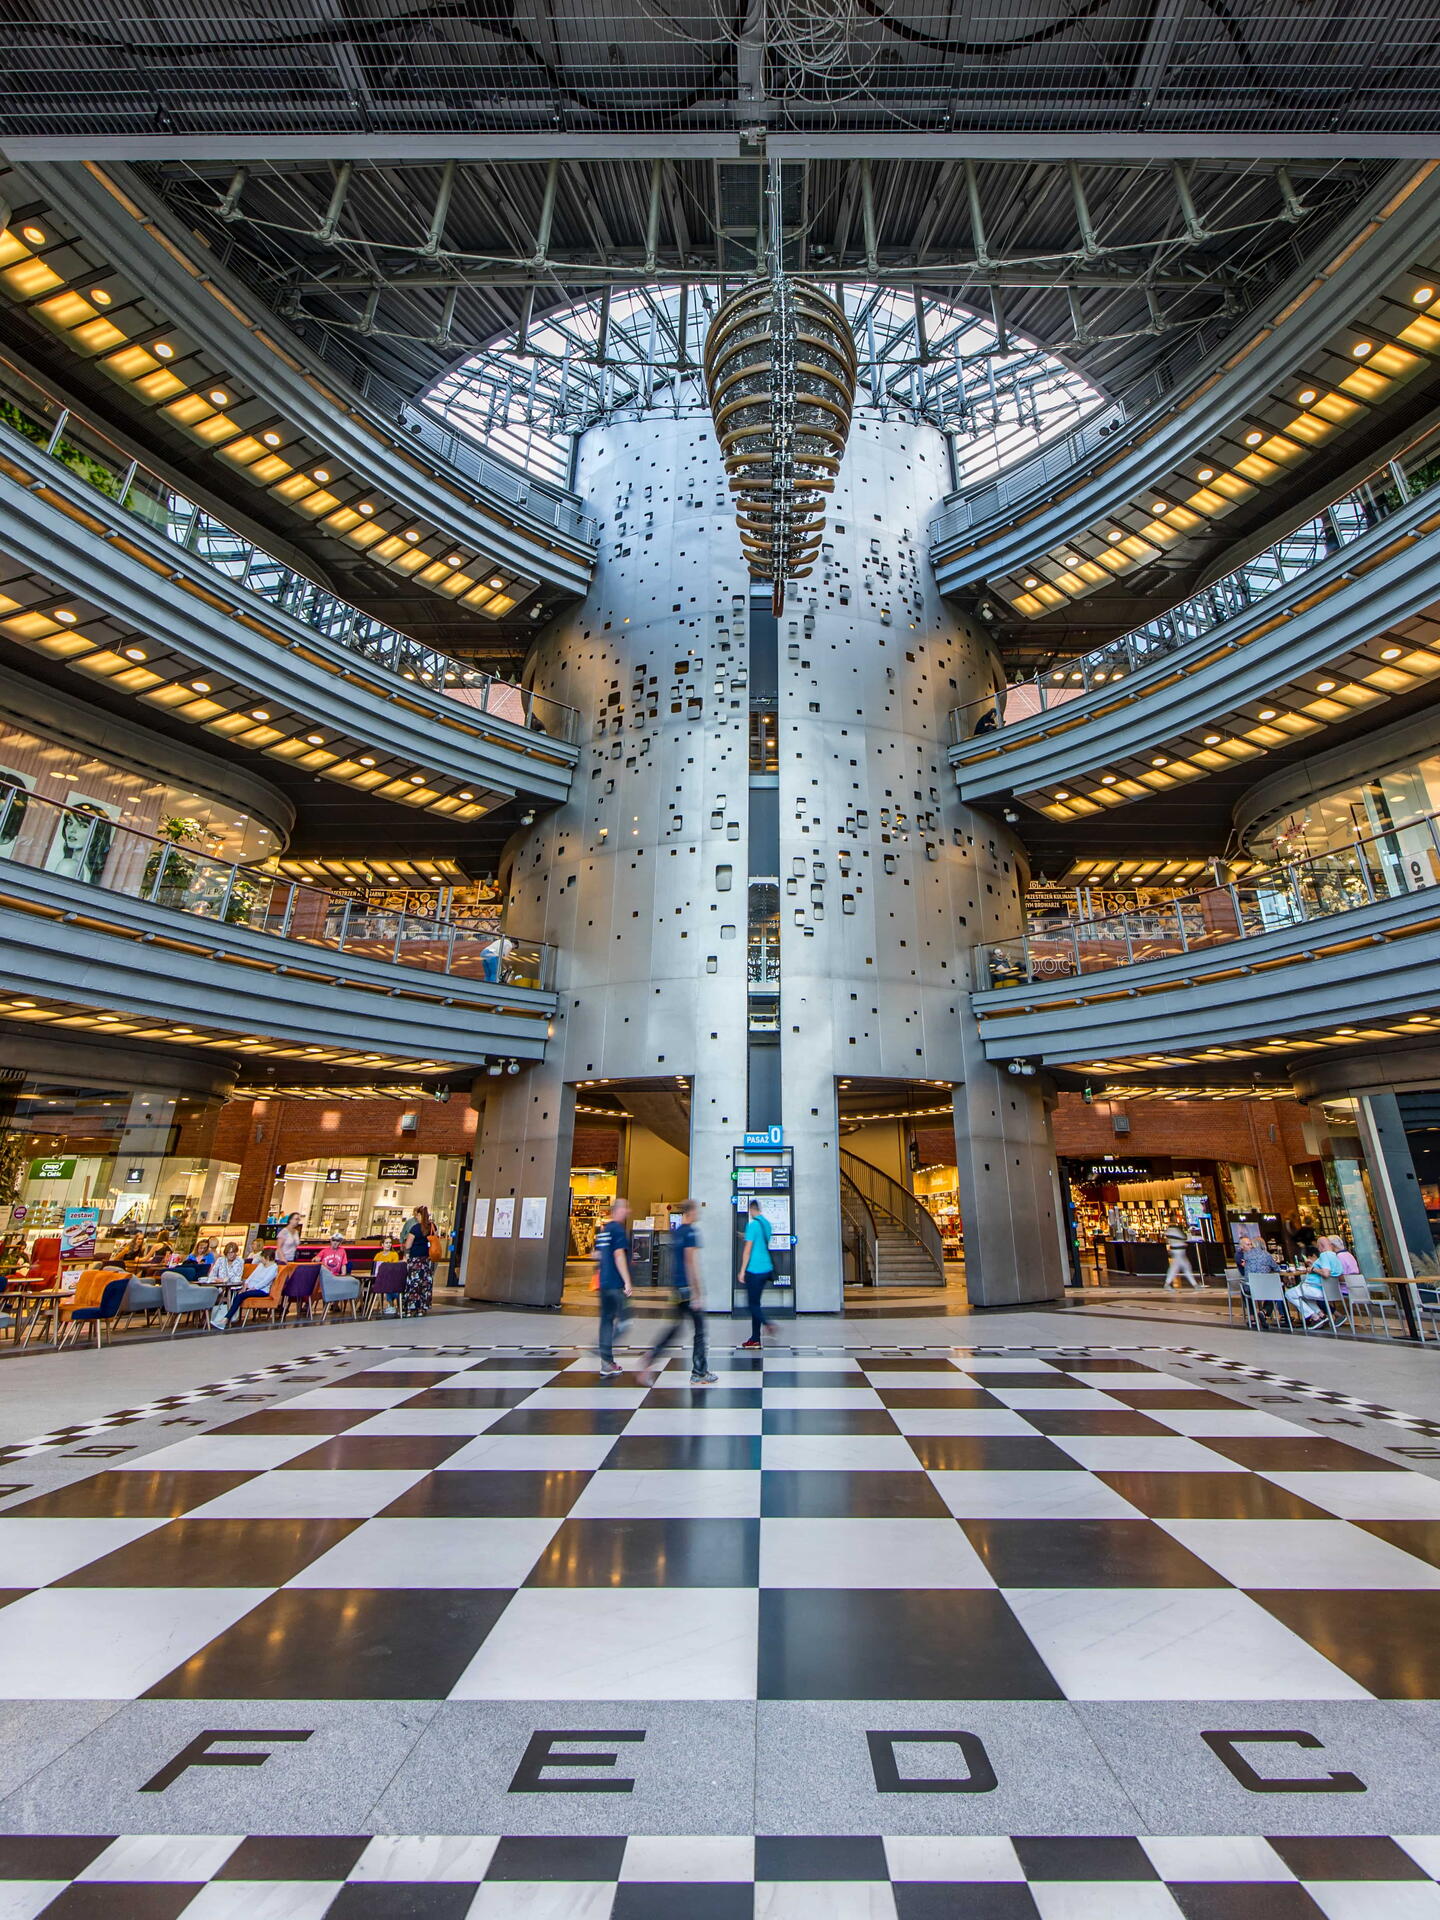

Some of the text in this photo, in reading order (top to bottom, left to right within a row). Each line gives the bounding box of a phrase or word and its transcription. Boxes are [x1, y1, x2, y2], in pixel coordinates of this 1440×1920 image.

[746, 1127, 781, 1144] PASAŻ 0
[70, 1211, 95, 1219] zestaw!
[136, 1729, 1369, 1793] F E D C
